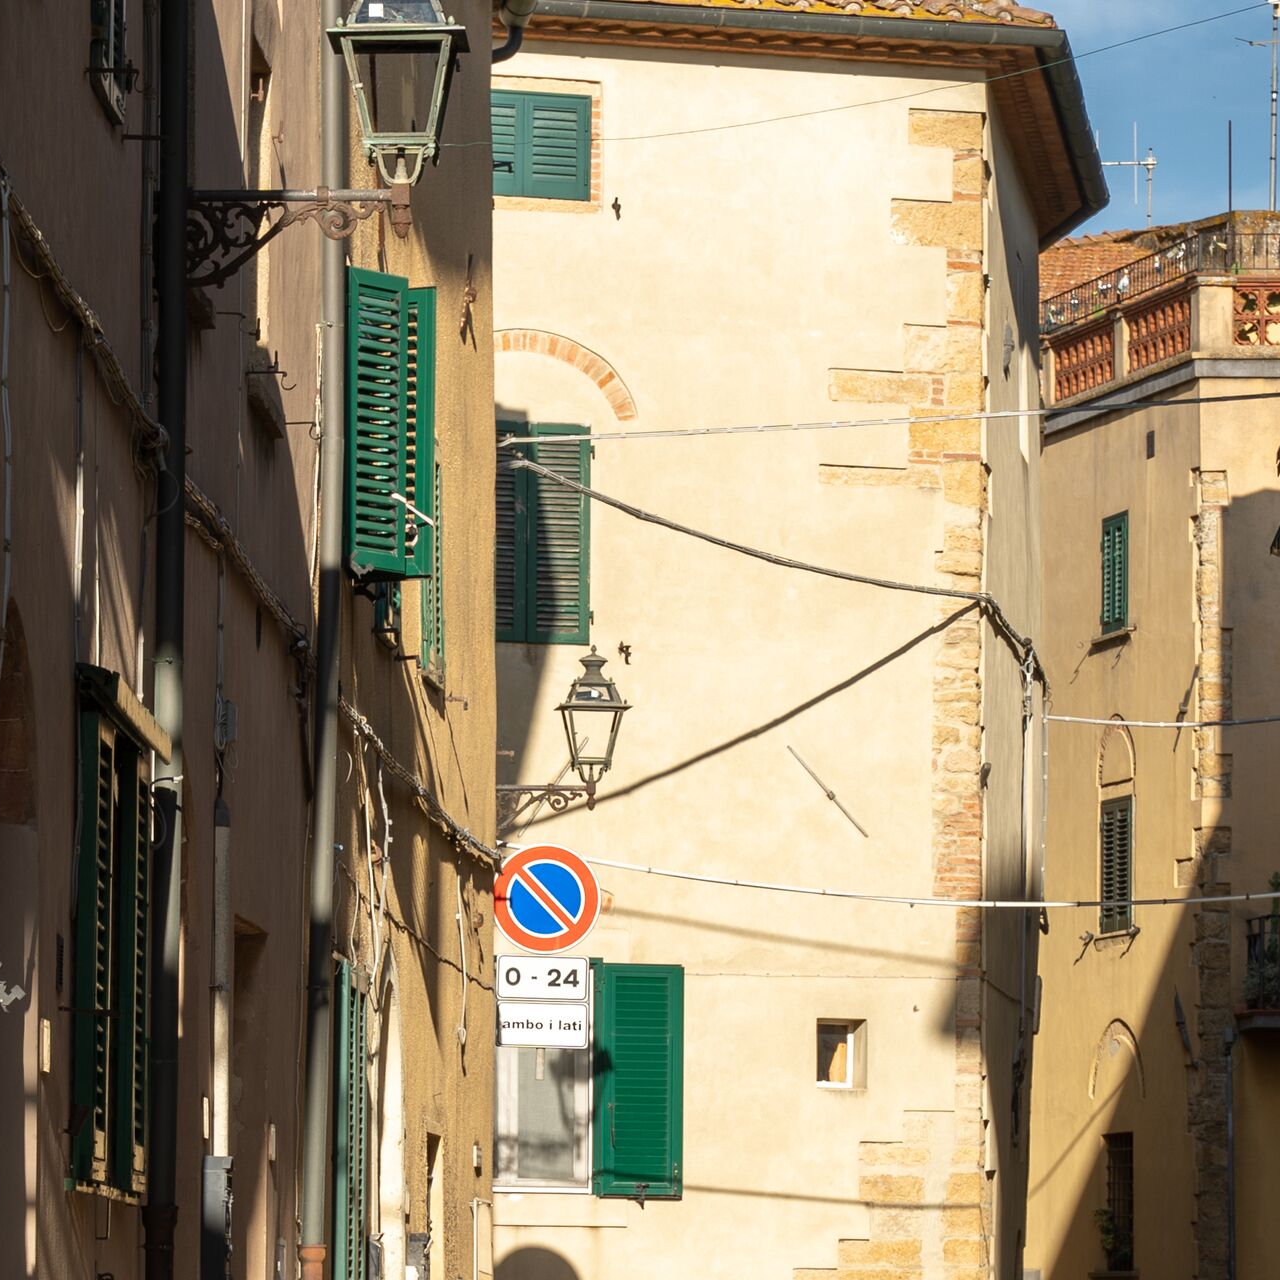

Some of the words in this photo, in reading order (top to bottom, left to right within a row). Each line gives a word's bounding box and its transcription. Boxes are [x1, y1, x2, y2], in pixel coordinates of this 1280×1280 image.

[505, 967, 521, 986] 0
[547, 968, 580, 988] 24
[502, 1019, 543, 1030] ambo
[549, 1020, 553, 1030] i
[558, 1020, 582, 1031] lati
